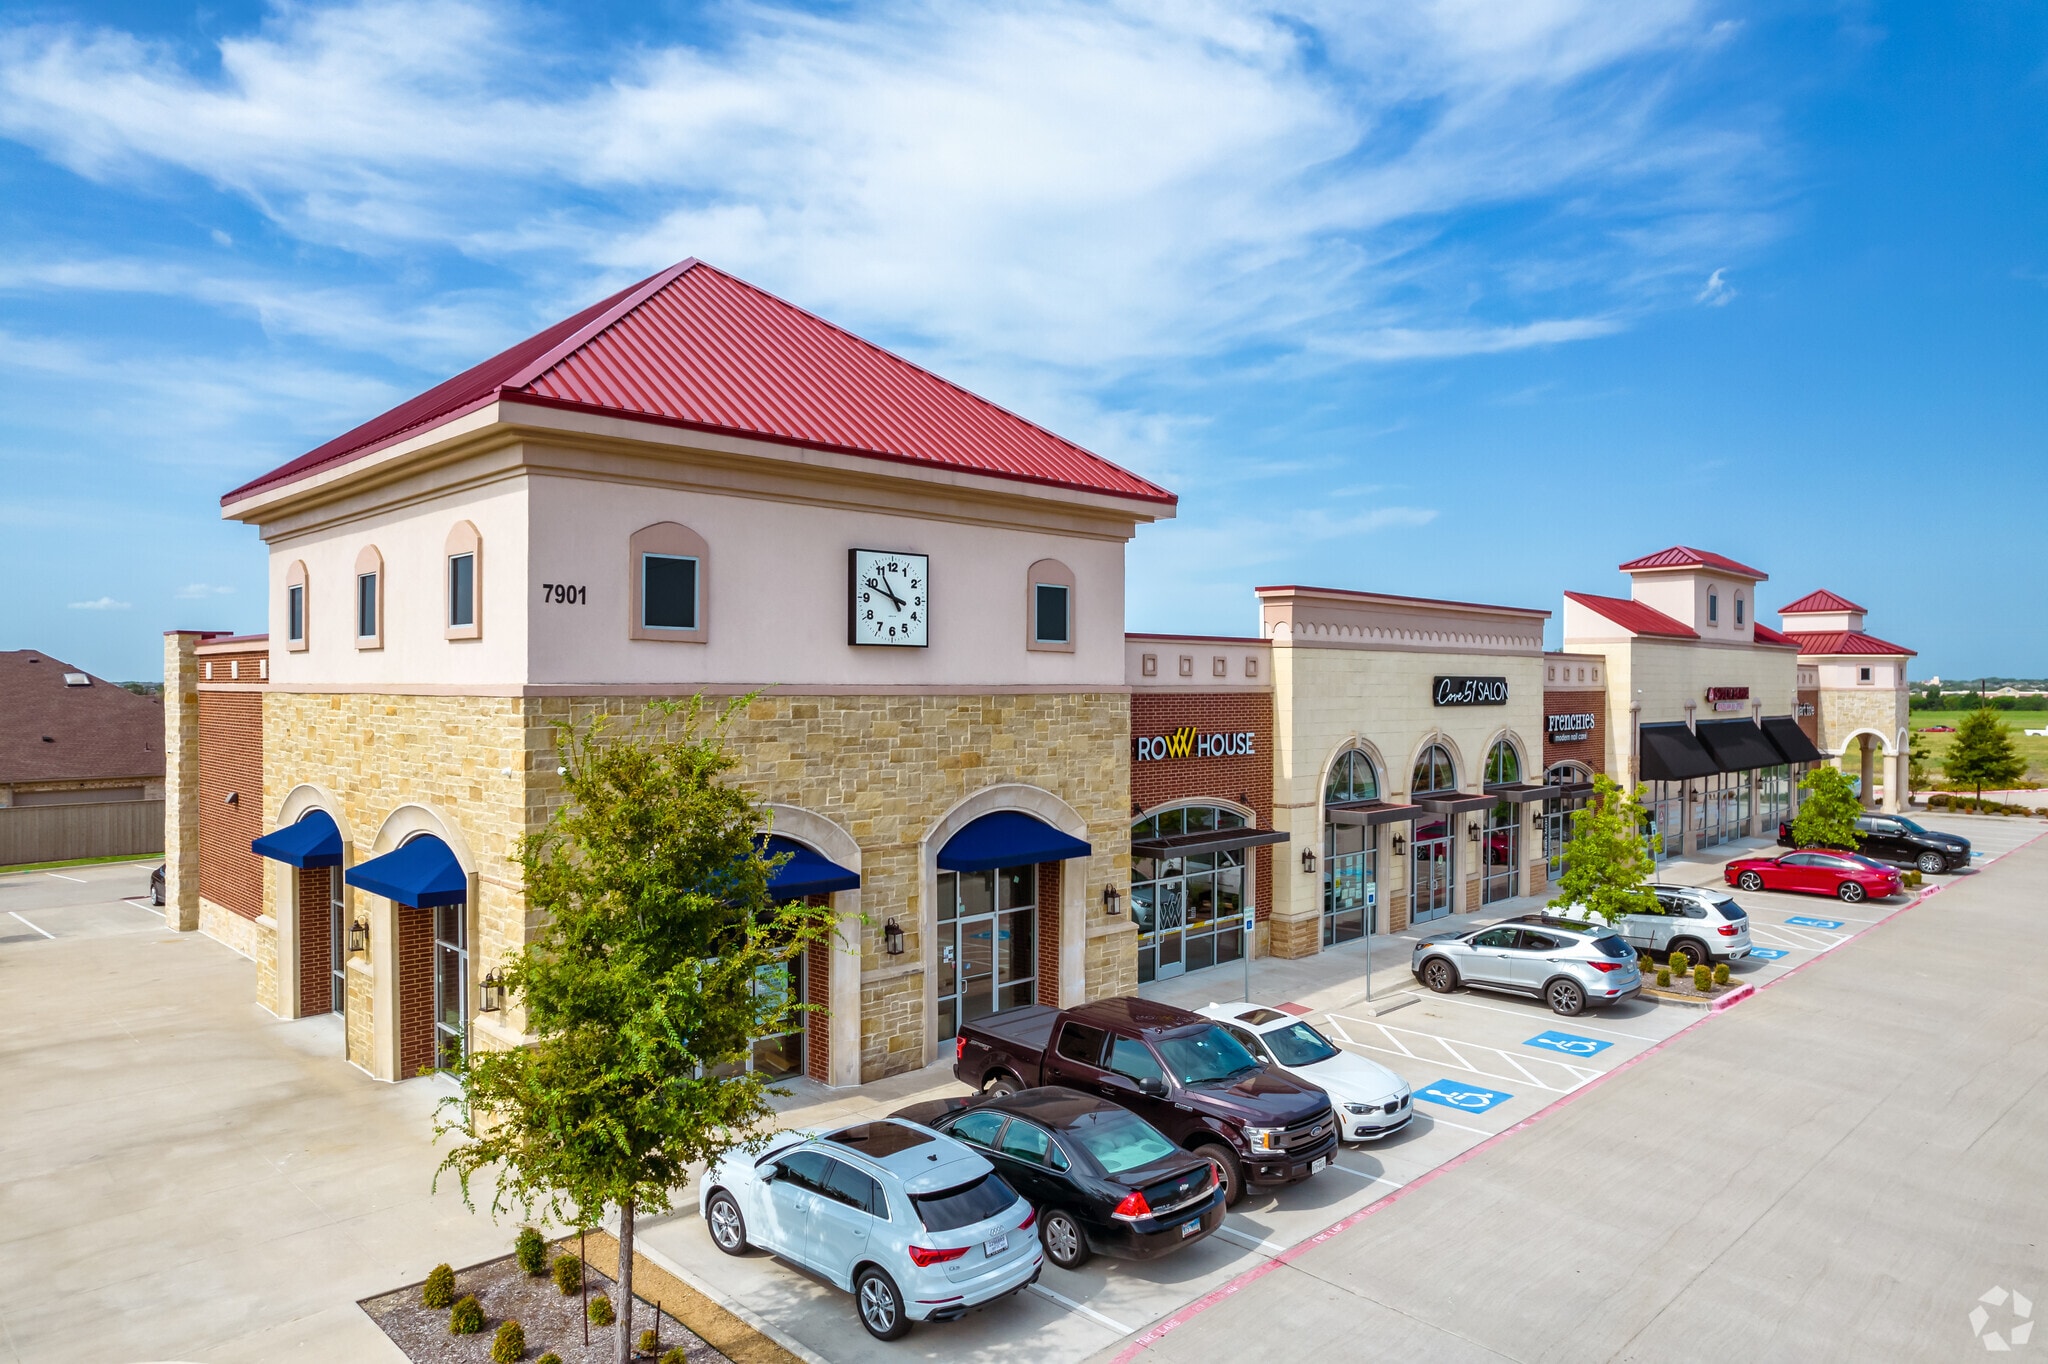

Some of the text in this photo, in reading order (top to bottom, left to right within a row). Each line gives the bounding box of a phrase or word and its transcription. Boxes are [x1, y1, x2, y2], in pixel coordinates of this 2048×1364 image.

[876, 566, 885, 576] 11
[887, 562, 898, 572] 12
[902, 568, 907, 577] 1
[867, 578, 878, 587] 10
[911, 579, 917, 588] 2
[543, 584, 586, 605] 7901
[863, 593, 870, 602] 9
[915, 597, 921, 606] 3
[866, 610, 873, 620] 8
[911, 612, 917, 621] 4
[877, 622, 883, 631] 7
[889, 626, 895, 636] 6
[902, 624, 908, 633] 5
[1478, 681, 1510, 700] SALON
[1197, 732, 1256, 757] HOUSE
